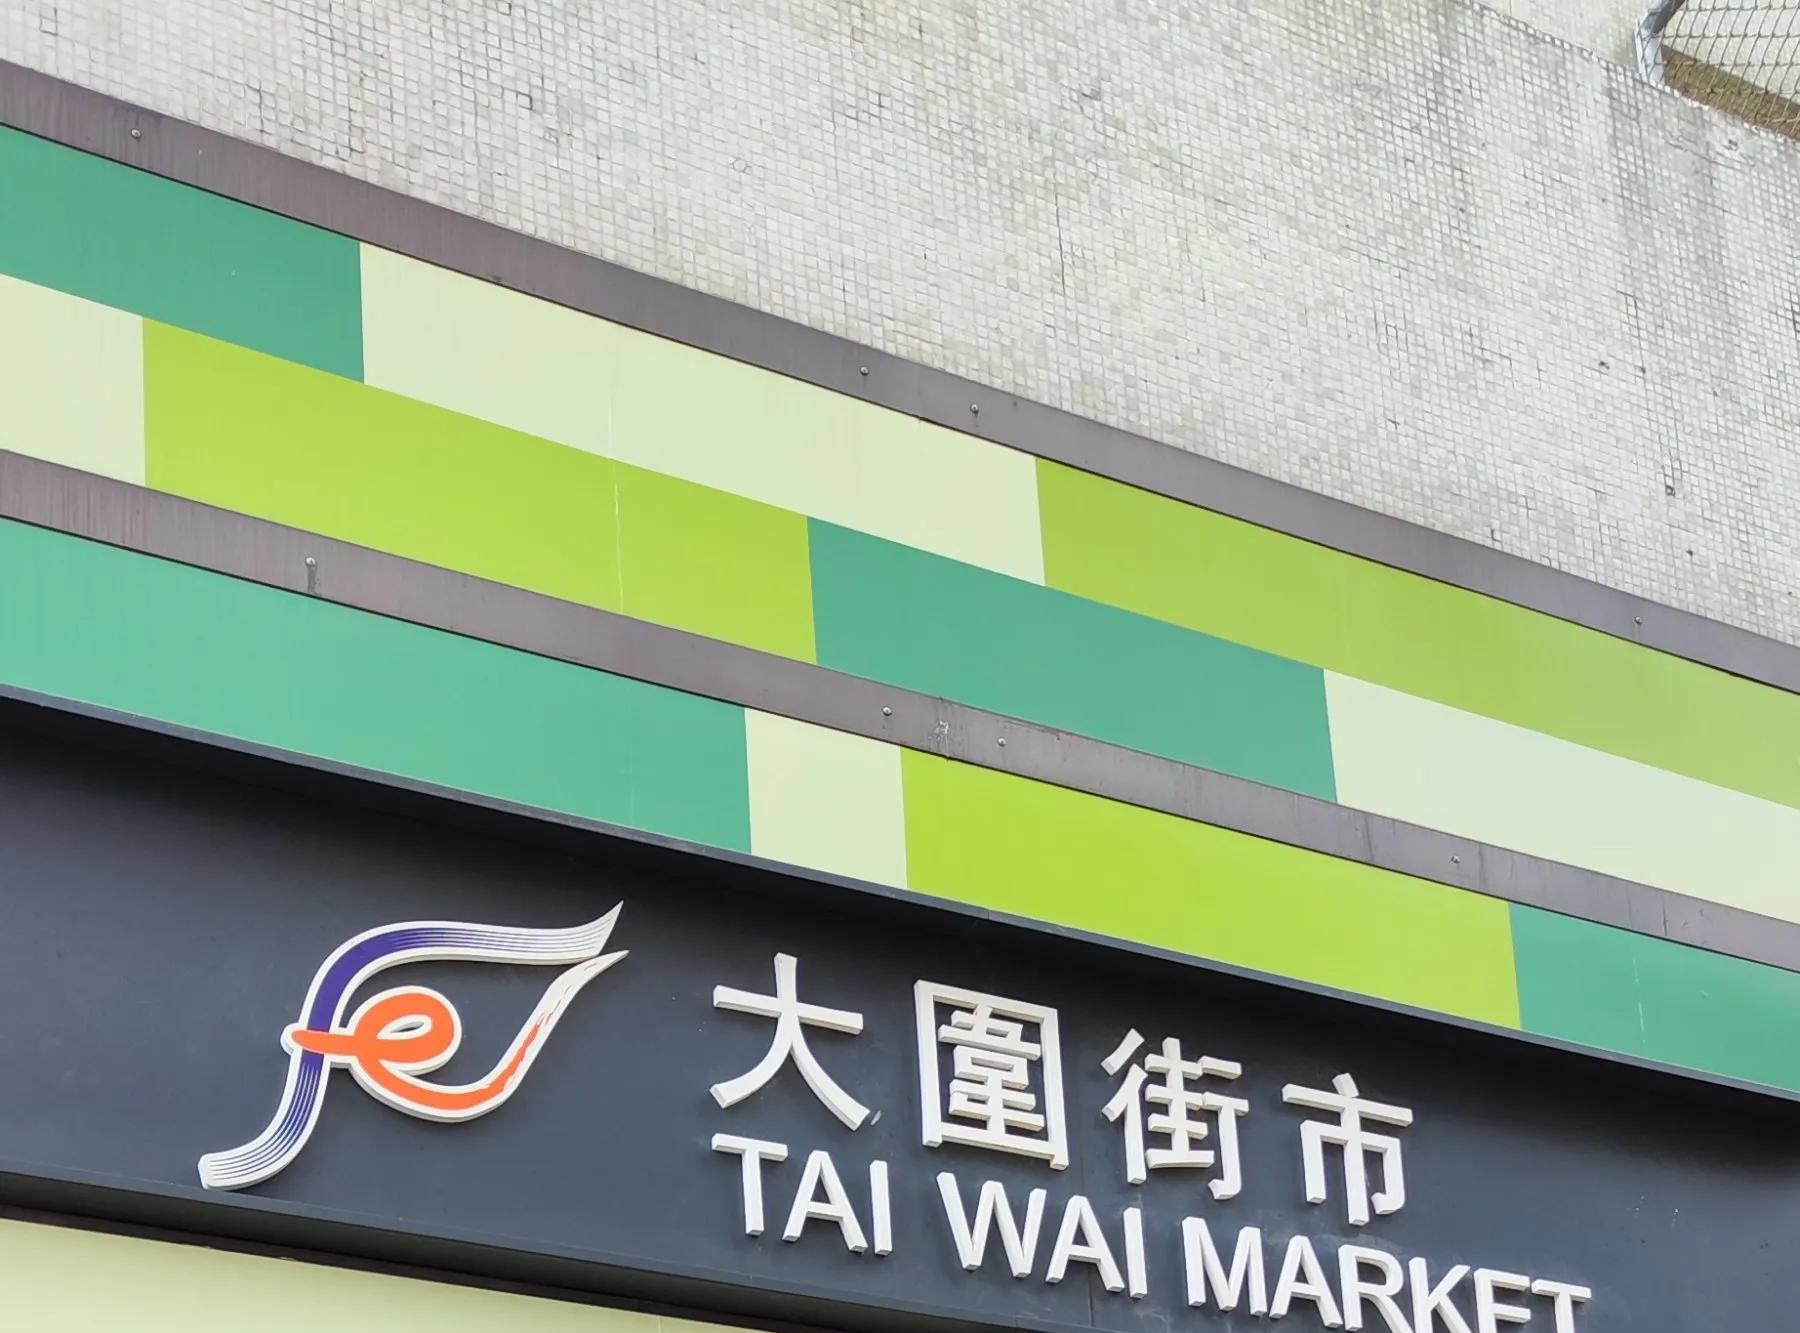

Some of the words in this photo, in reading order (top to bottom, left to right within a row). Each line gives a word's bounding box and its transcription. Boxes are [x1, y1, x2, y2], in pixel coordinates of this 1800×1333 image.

[711, 952, 1413, 1226] 大圍街市
[711, 1132, 893, 1256] TAI
[936, 1171, 1147, 1299] WAI
